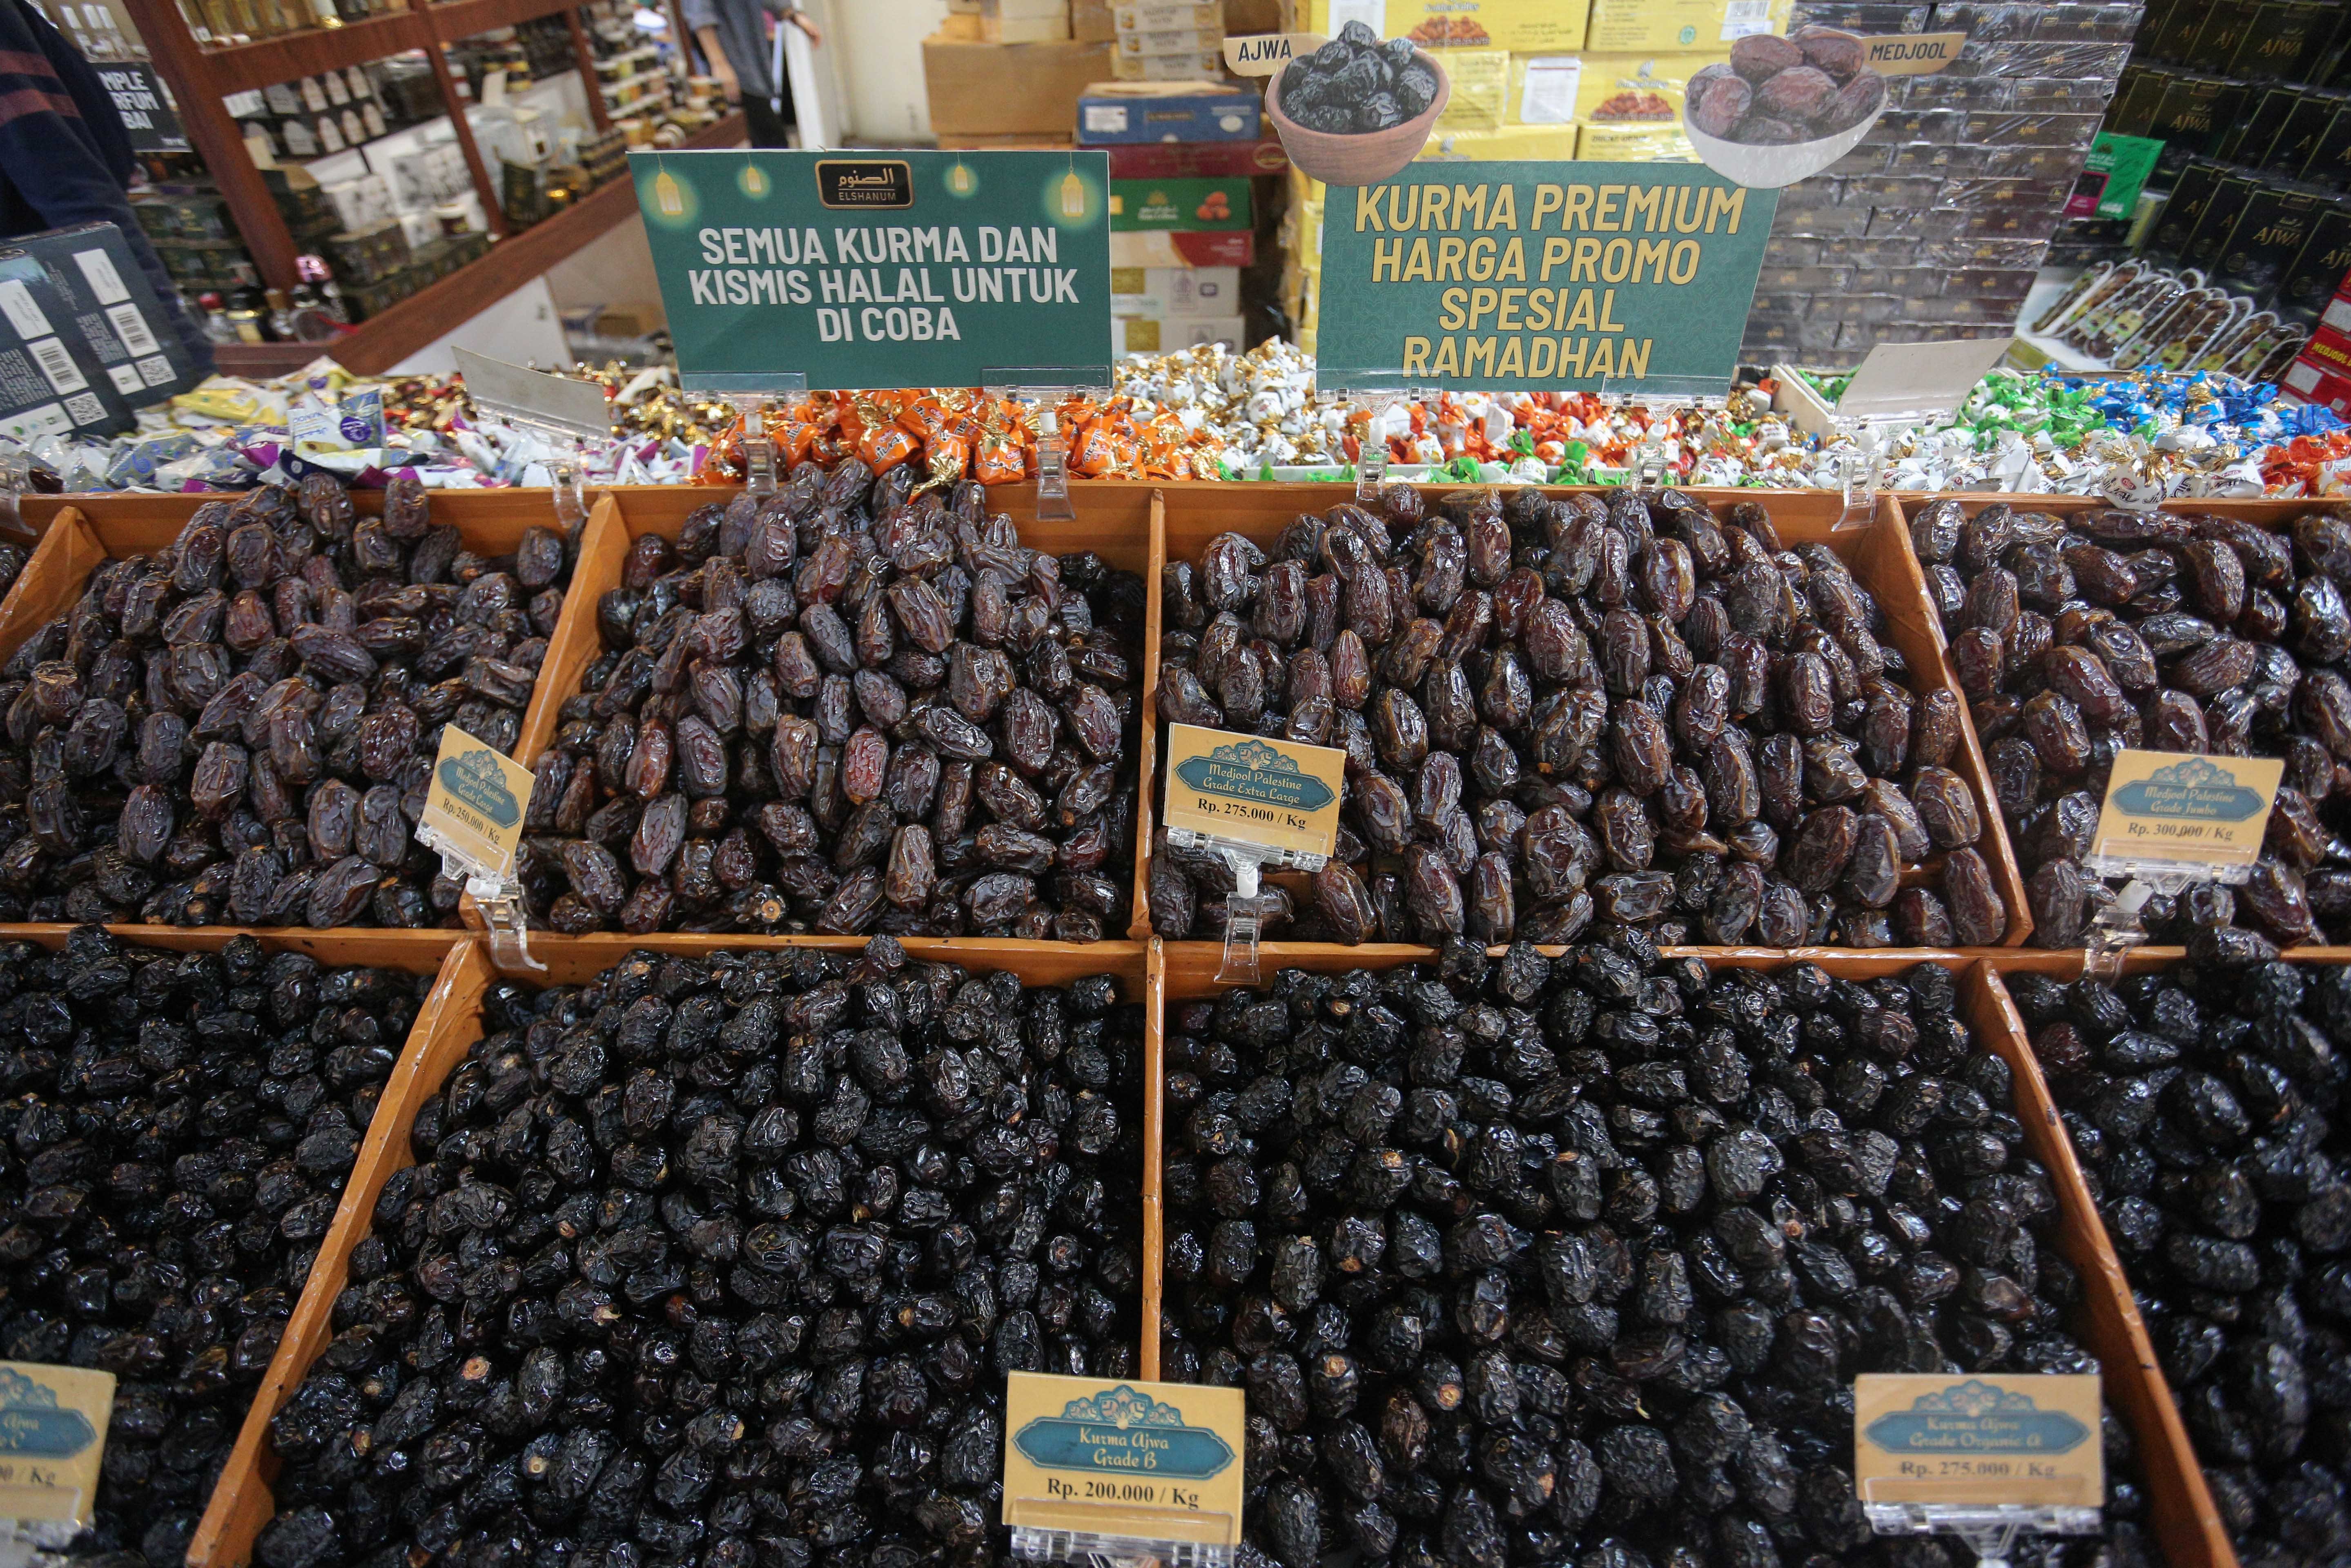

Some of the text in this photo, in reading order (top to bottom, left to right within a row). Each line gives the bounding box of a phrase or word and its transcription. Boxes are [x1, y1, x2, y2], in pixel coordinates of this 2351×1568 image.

[1237, 40, 1292, 62] AJWA
[1869, 42, 1947, 61] MEDJOOL
[838, 167, 894, 188] الصنوم
[838, 192, 896, 201] ELSHANUM
[1355, 185, 1747, 234] KURMA PREMIUM
[699, 226, 1057, 265] SEMUA KURMA DAN
[1372, 237, 1700, 285] HARGA PROMO
[688, 267, 1079, 305] KISMIS HALAL UNTUK
[1439, 287, 1625, 332] SPESIAL
[816, 307, 961, 342] DI COBA
[1402, 336, 1653, 379] RAMADHAN
[2311, 343, 2347, 364] MEDJOOL
[456, 766, 505, 805] Medjool Palestine
[1209, 764, 1302, 790] Medjool Palestine
[458, 784, 493, 813] Grade Large
[1203, 777, 1300, 805] Grade Extra Large
[2145, 786, 2235, 802] Medjool Palestine
[1198, 798, 1306, 831] Rp. 275.000 / Kg
[2150, 800, 2182, 813] Grade
[443, 798, 500, 844] Rp. 250.000 / Kg
[2128, 822, 2150, 836] Rp.
[2205, 827, 2211, 837] /
[2214, 827, 2233, 842] Kg
[1927, 1417, 1977, 1430] Kurma
[1080, 1427, 1169, 1452] Kurma Ajwa
[1909, 1432, 1957, 1447] Grade
[1094, 1449, 1157, 1469] Grade B
[1901, 1461, 2056, 1479] Rp. 275.000 / Kg
[1047, 1478, 1199, 1511] Rp. 200.000 / Kg
